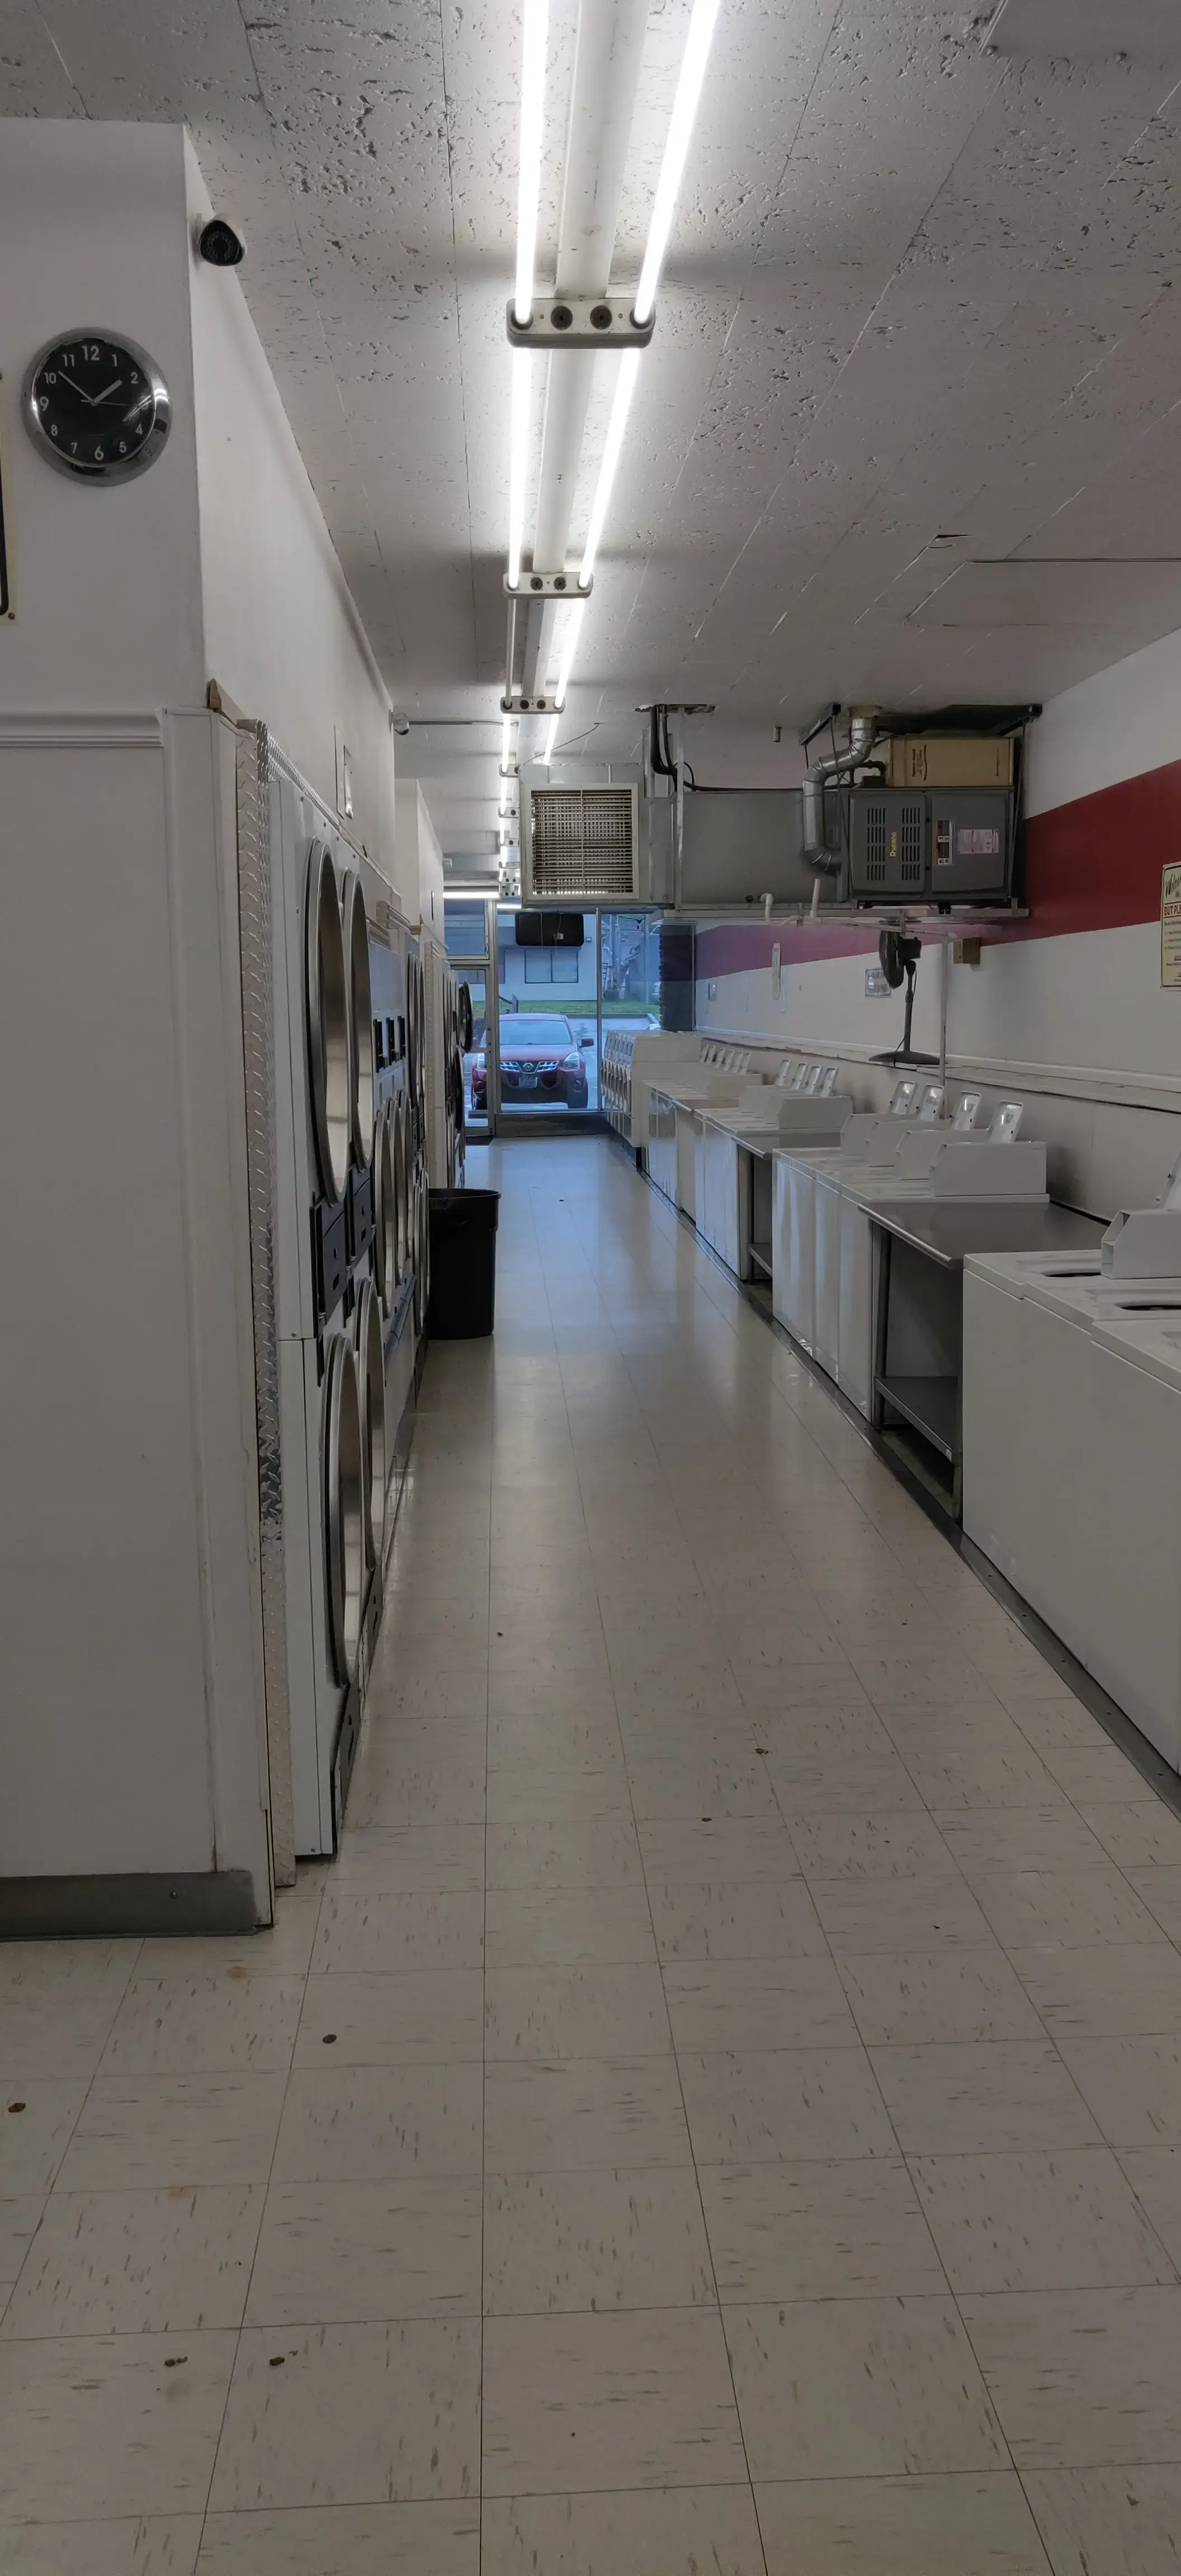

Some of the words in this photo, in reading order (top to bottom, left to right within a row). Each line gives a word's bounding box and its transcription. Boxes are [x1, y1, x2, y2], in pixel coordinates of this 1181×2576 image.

[82, 345, 100, 361] 12
[63, 353, 75, 367] 11
[111, 354, 118, 367] 1
[44, 372, 57, 385] 10
[130, 372, 139, 384] 2
[40, 396, 49, 411] 9
[51, 424, 58, 437] 8
[135, 423, 143, 435] 4
[70, 442, 78, 454] 7
[94, 445, 105, 461] 6
[119, 441, 127, 454] 5
[1164, 906, 1173, 916] BUT
